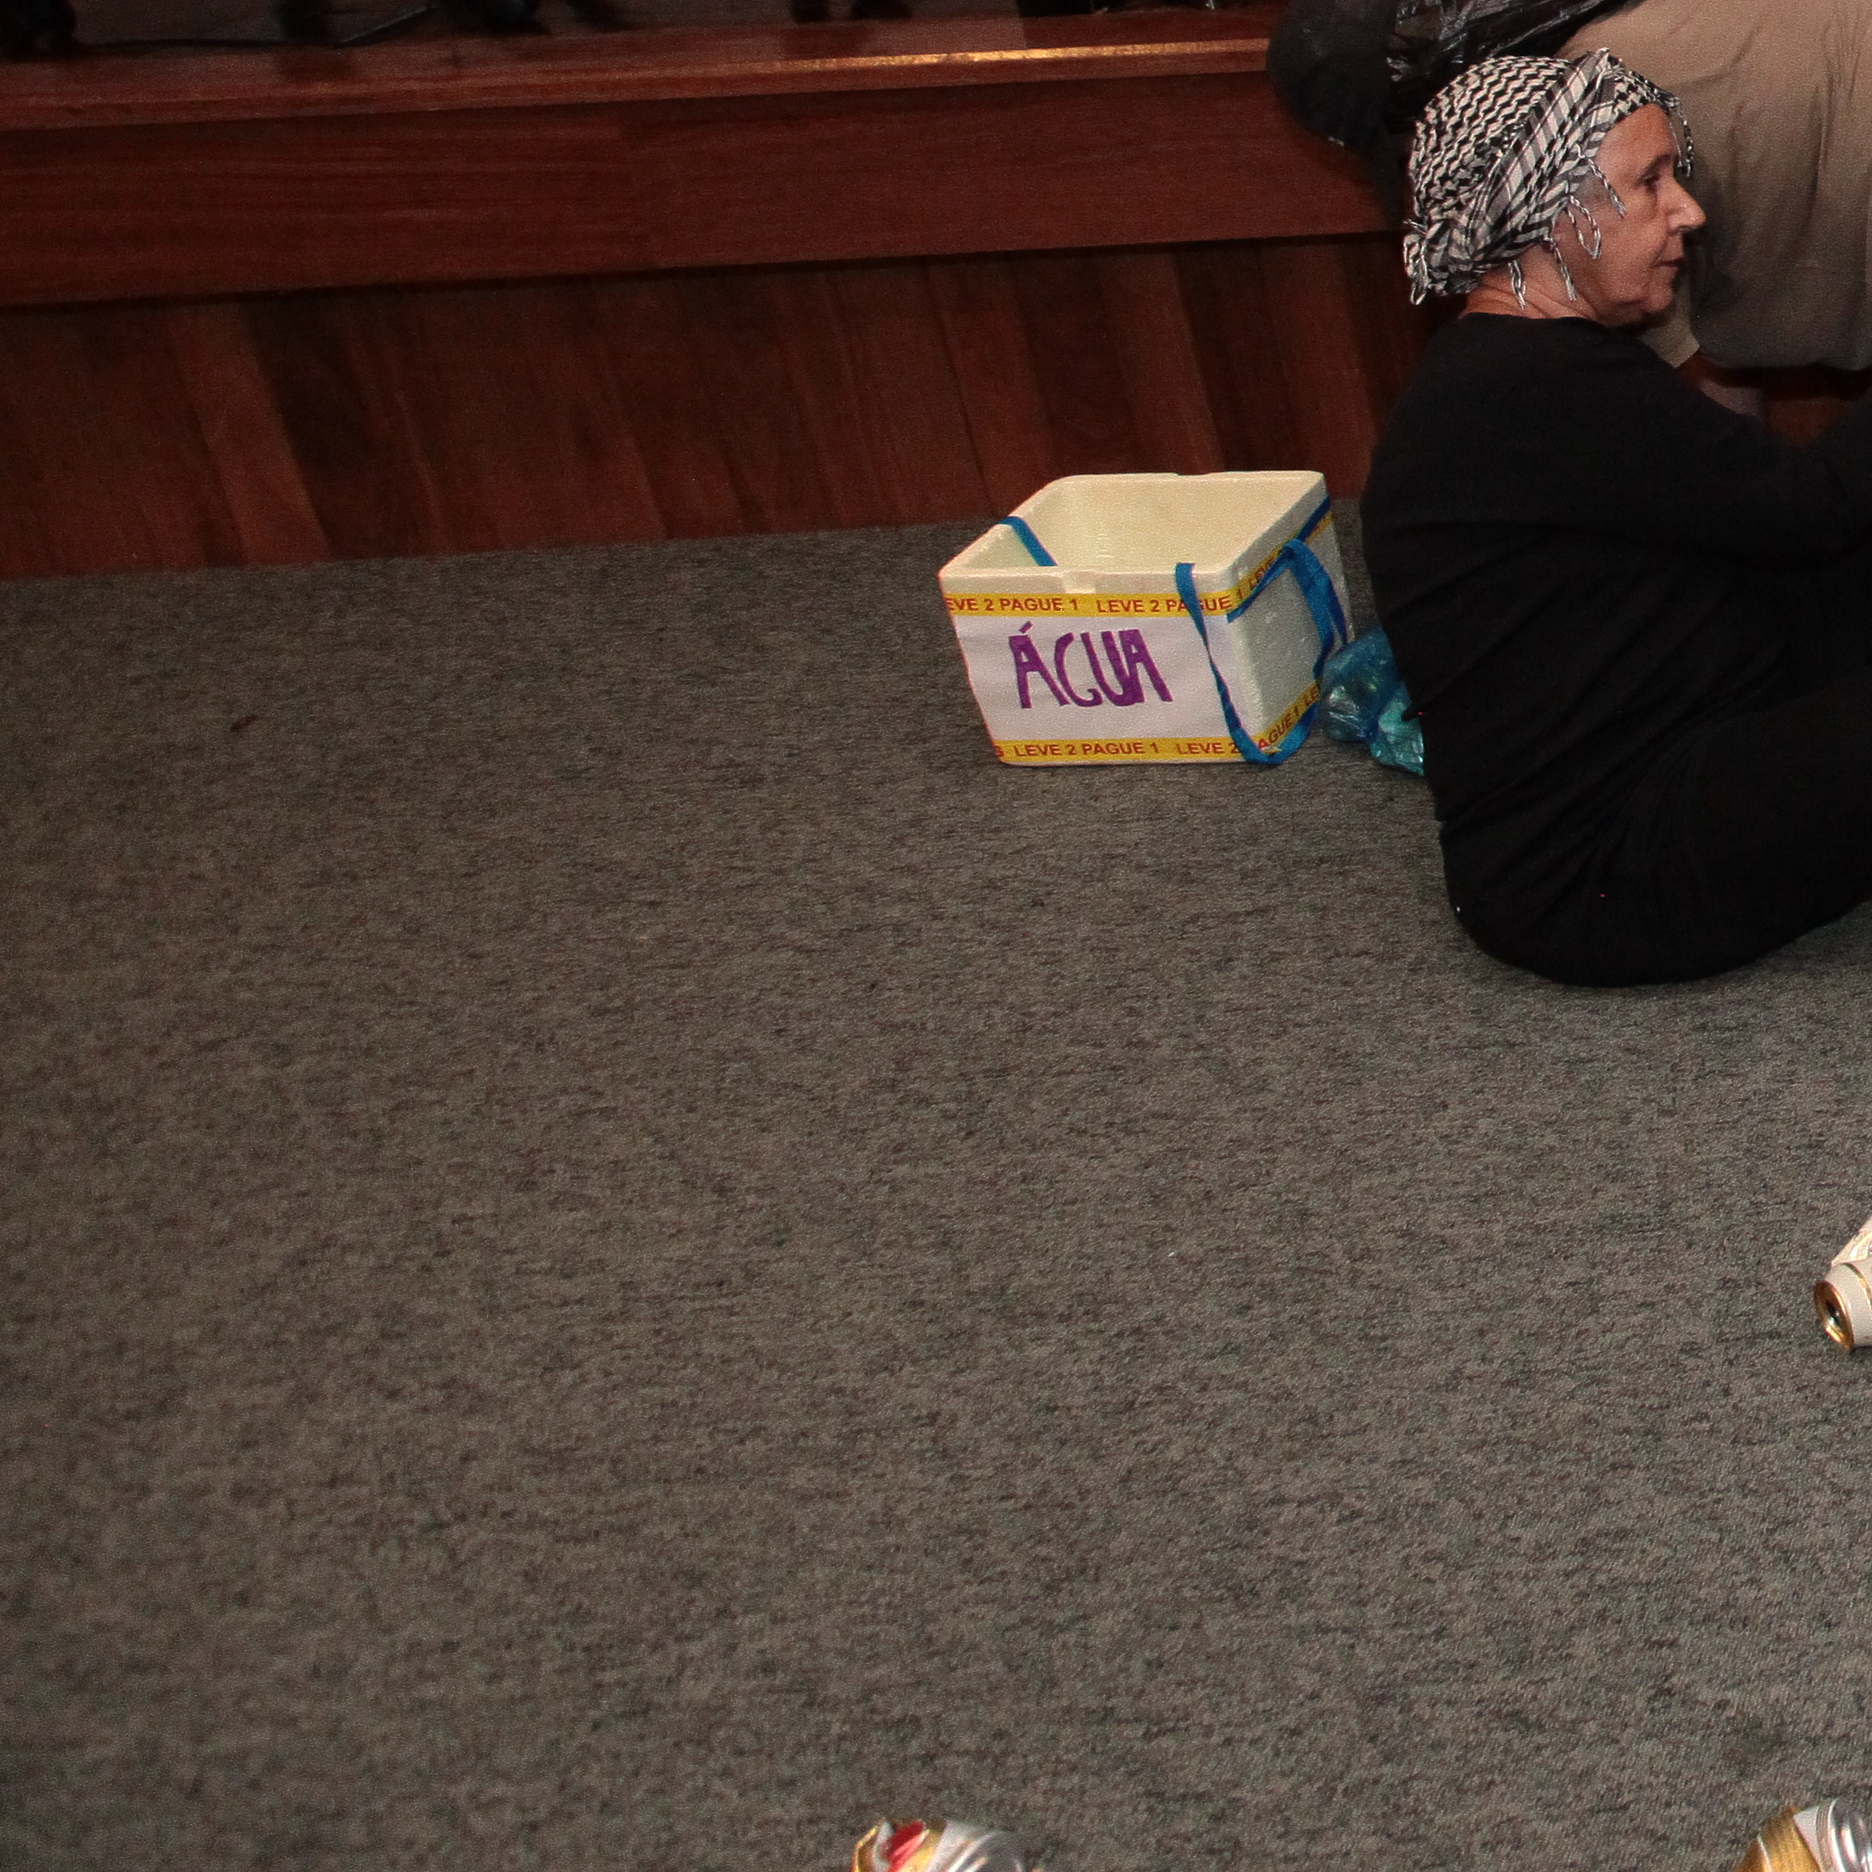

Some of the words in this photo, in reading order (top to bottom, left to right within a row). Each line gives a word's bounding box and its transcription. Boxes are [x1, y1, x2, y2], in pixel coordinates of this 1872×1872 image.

[945, 598, 979, 611] EVE
[984, 599, 995, 611] 2
[999, 598, 1065, 611] PAGUE
[1070, 599, 1079, 610] 1
[1096, 600, 1144, 613] LEVE
[1150, 600, 1160, 613] 2
[1014, 744, 1062, 757] LEVE
[1067, 744, 1077, 756] 2
[1081, 742, 1146, 755] PAGUE
[1150, 742, 1160, 754] 1
[1176, 742, 1224, 755] LEVE
[1257, 712, 1294, 750] AGUE
